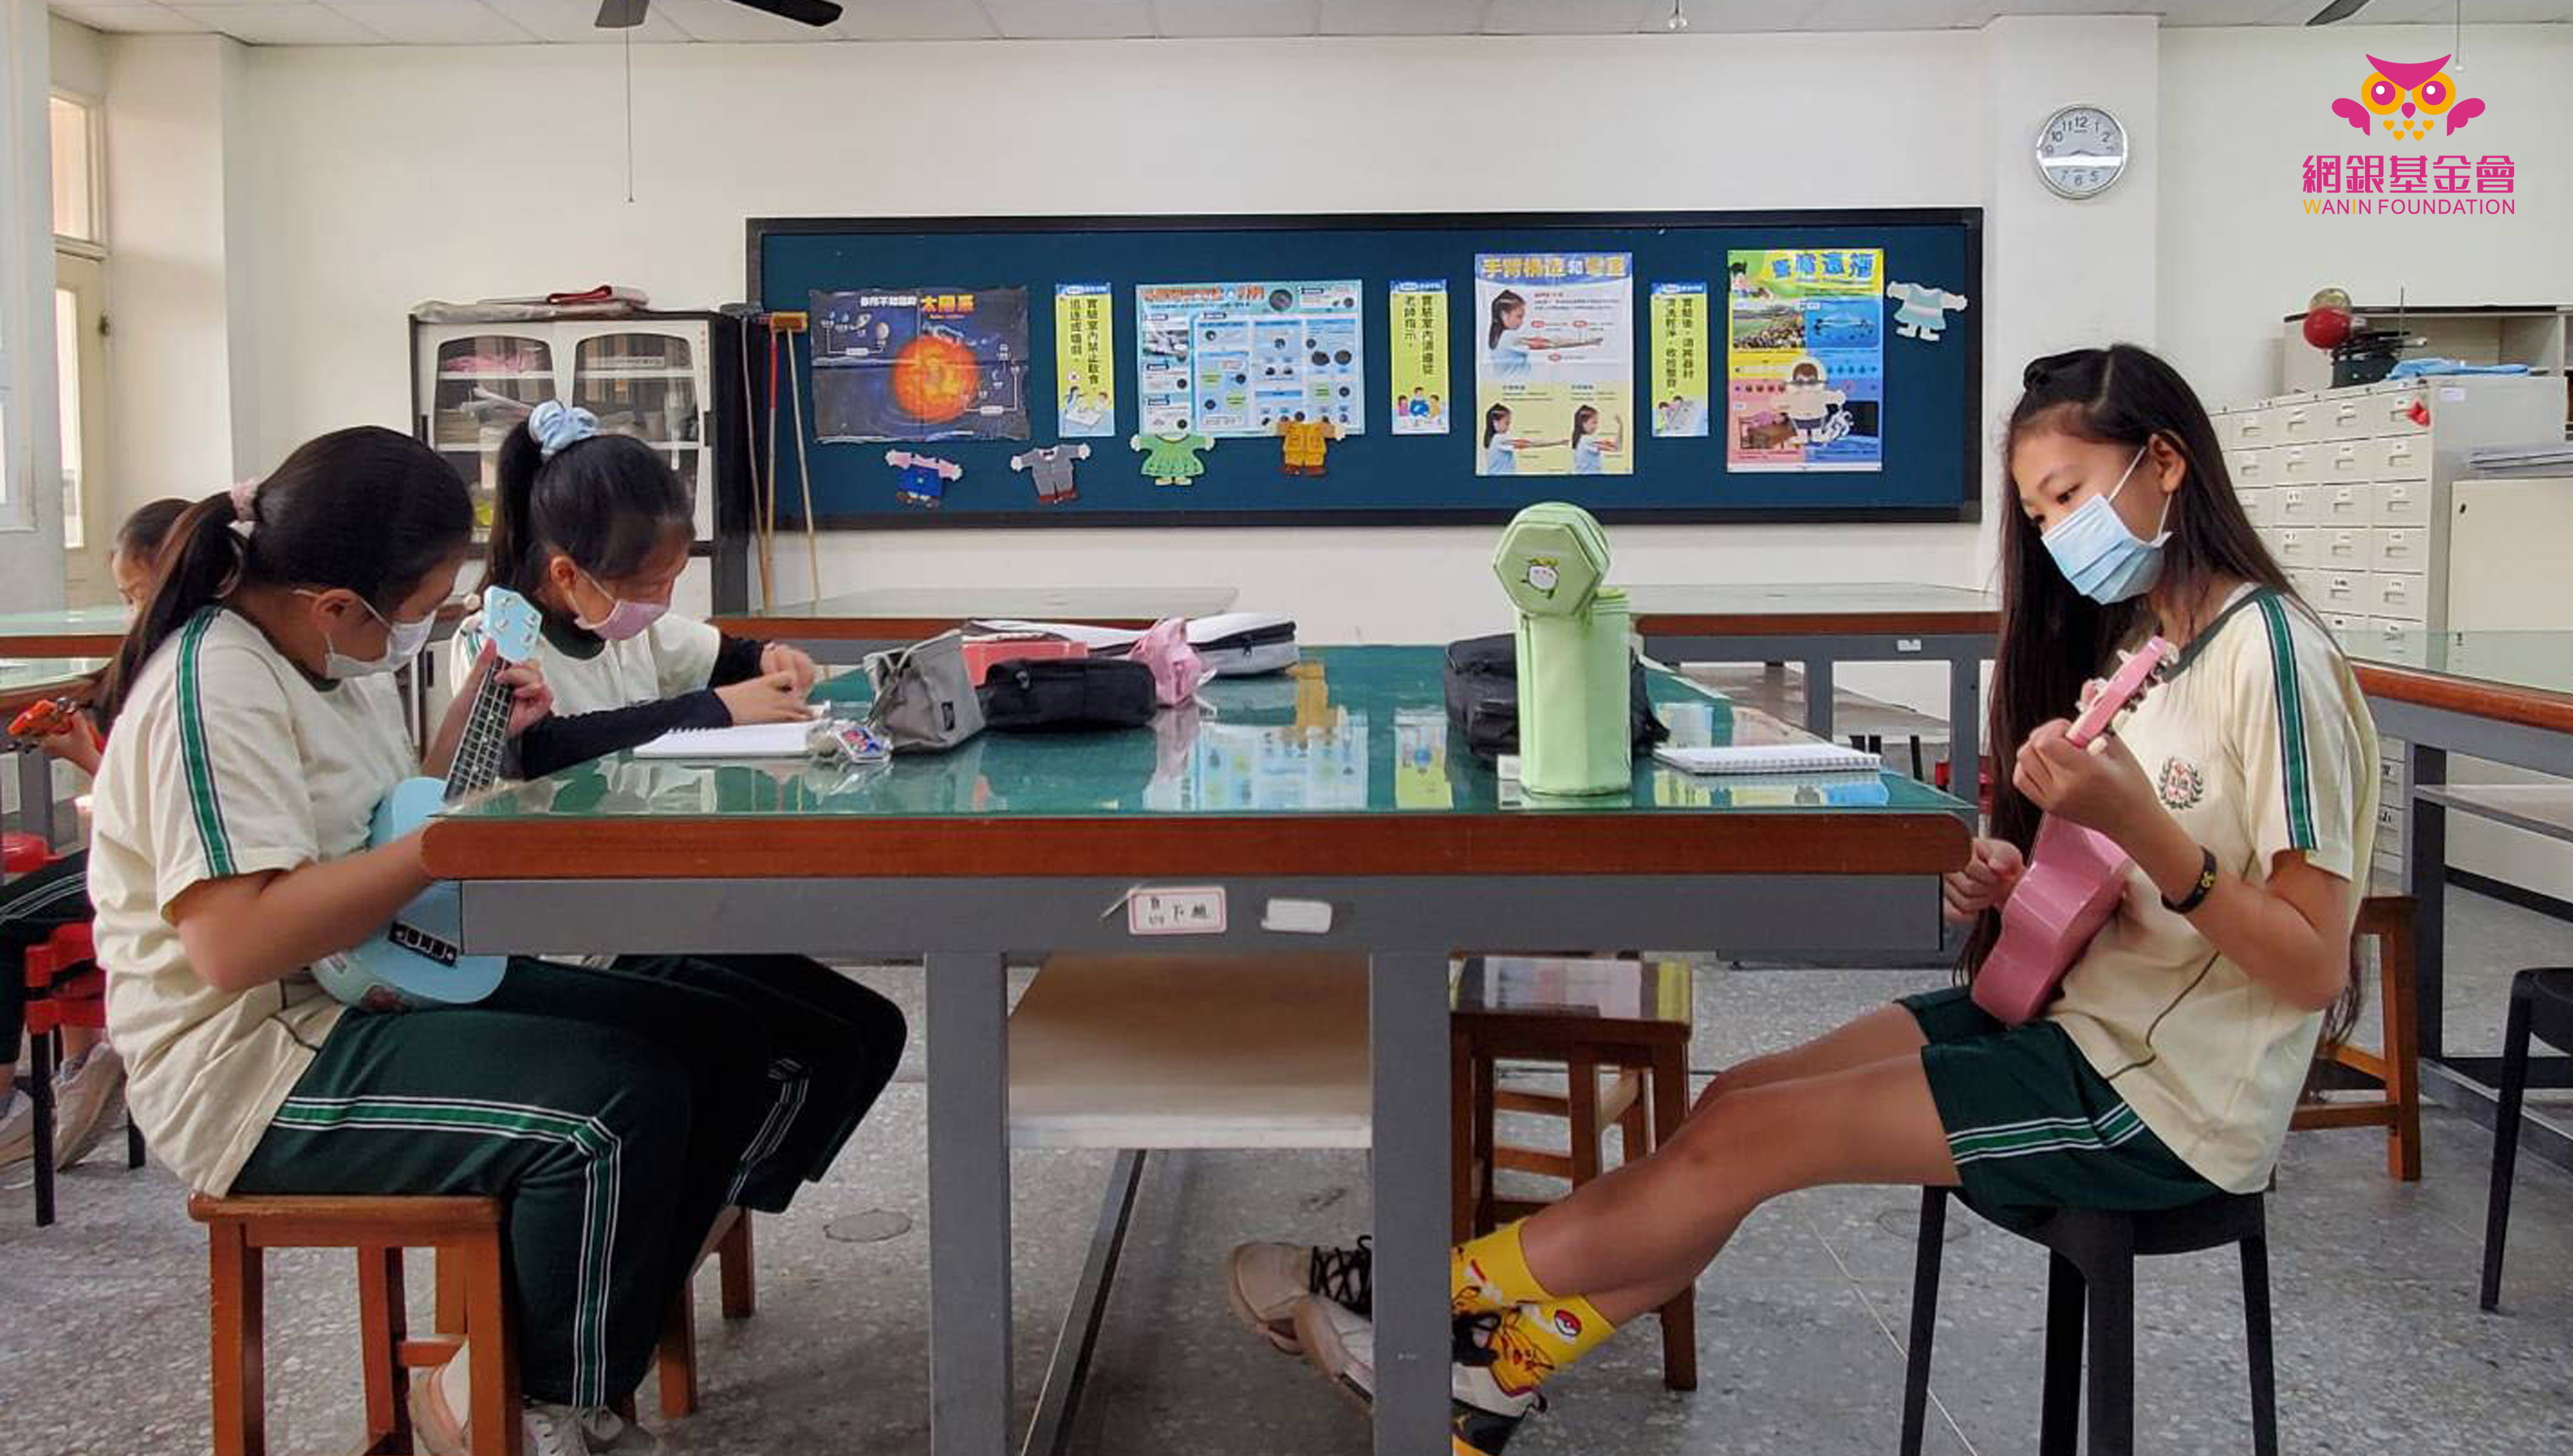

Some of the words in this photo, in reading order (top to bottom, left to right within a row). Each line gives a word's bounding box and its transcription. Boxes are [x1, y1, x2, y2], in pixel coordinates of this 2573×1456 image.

[2063, 120, 2072, 131] 11
[2075, 116, 2088, 127] 12
[2094, 121, 2099, 132] 1
[2052, 130, 2063, 143] 10
[2101, 131, 2111, 143] 2
